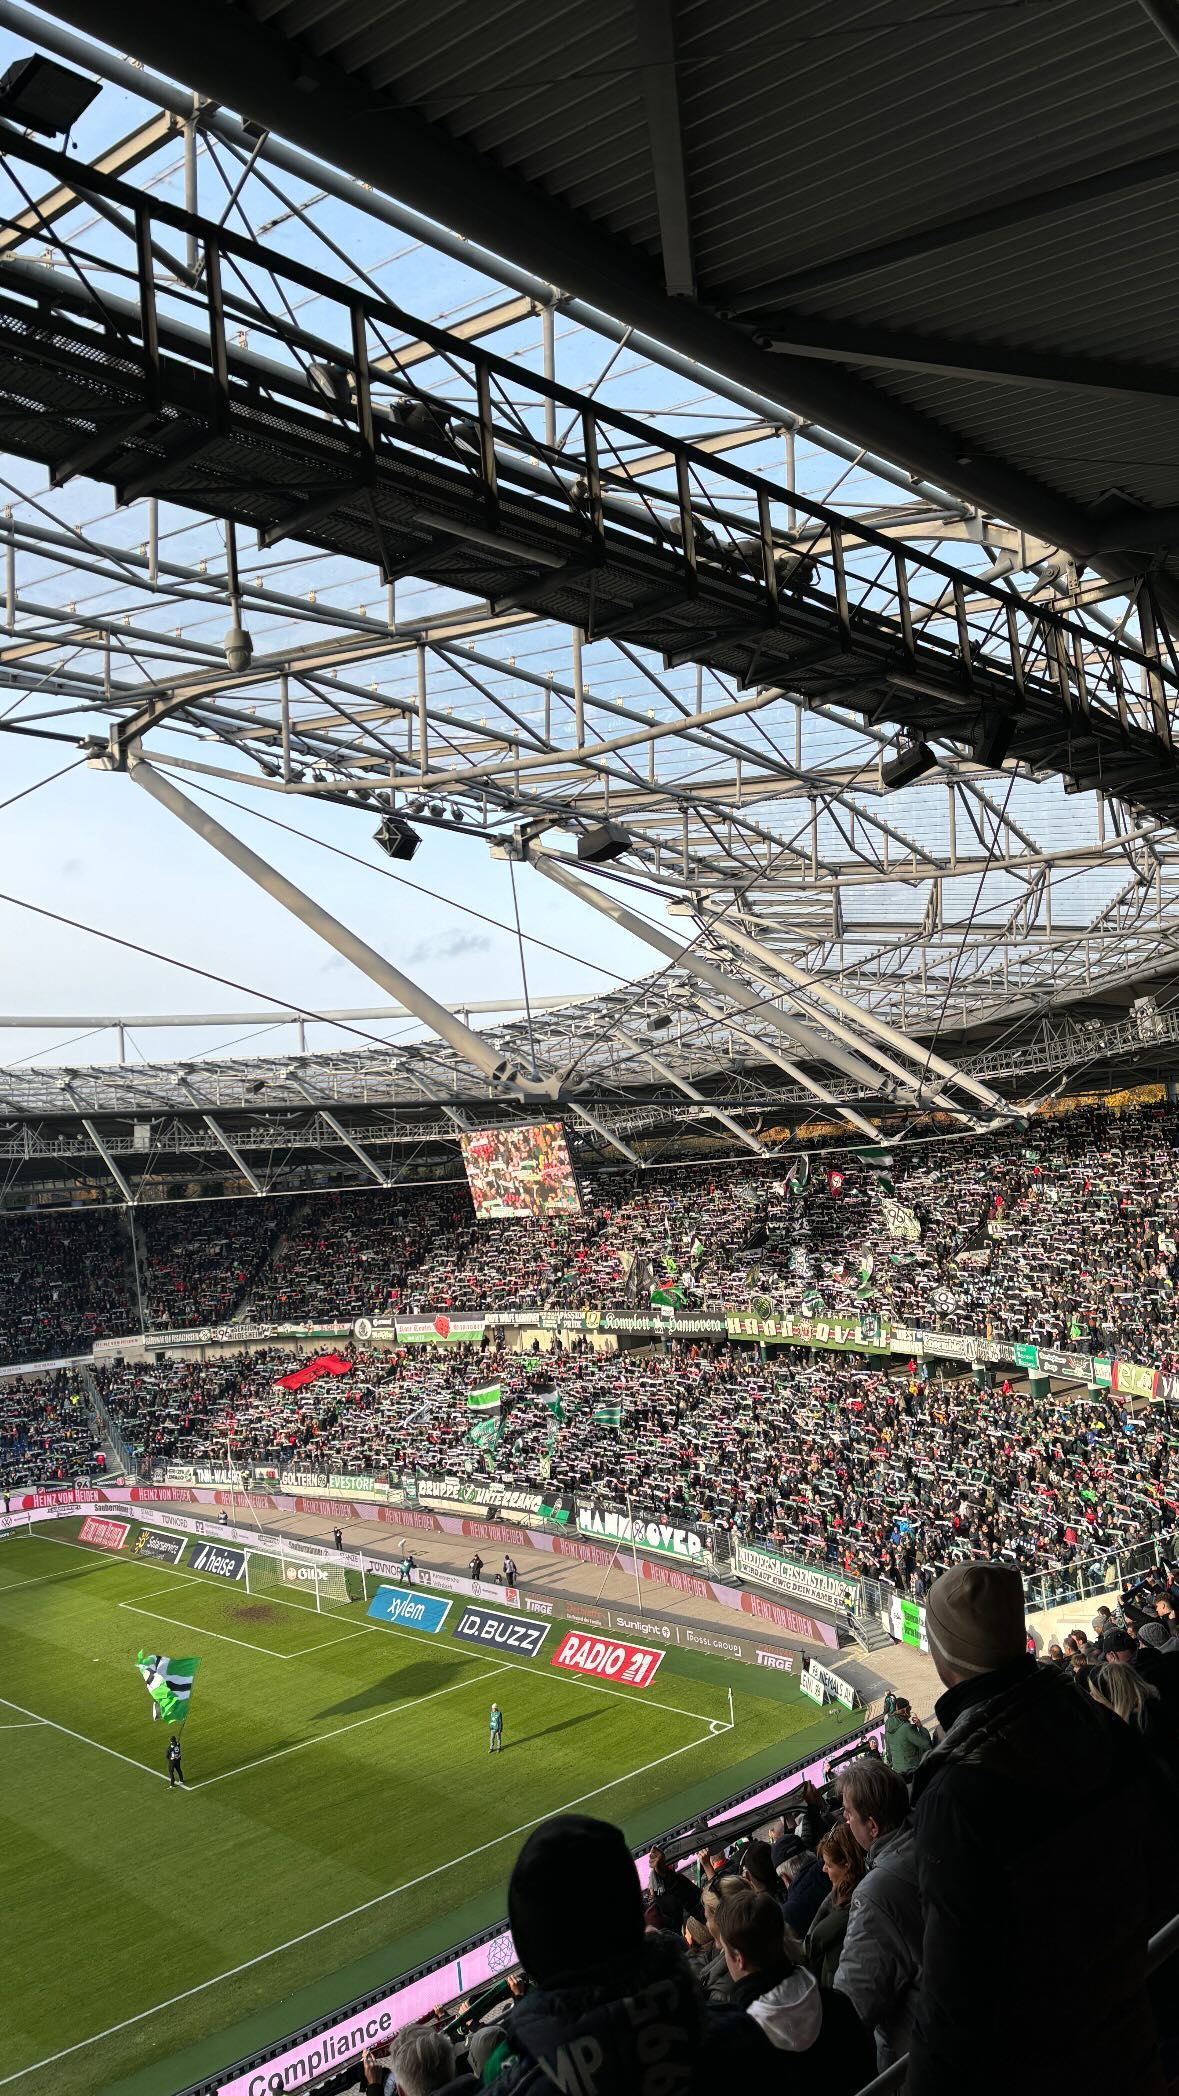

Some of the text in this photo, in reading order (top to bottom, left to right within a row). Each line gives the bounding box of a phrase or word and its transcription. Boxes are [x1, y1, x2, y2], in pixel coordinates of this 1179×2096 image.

[282, 1472, 318, 1487] GOLTERN
[329, 1476, 375, 1491] EVESTORF
[33, 1489, 99, 1508] HEINZ VON HEIDEN
[139, 1488, 191, 1503] HEINZ VON HEIDEN
[302, 1499, 352, 1517] HEINZ VON HEIDEN
[384, 1508, 434, 1529] HEINZ VON HEIDEN
[469, 1522, 524, 1545] HEINZ VON HEIDEN
[205, 1549, 236, 1577] heise
[792, 1583, 811, 1596] DEIN
[387, 1593, 426, 1621] xylem
[525, 1598, 553, 1615] TIRGE
[751, 1595, 813, 1637] HEINZ VON HEIDEN
[457, 1614, 541, 1650] ID.BUZZ
[616, 1617, 660, 1634] Sunlight
[713, 1640, 738, 1652] GROUP
[557, 1636, 653, 1683] RADIO 21
[755, 1650, 793, 1672] TIRGE
[248, 2011, 393, 2096] Compliance
